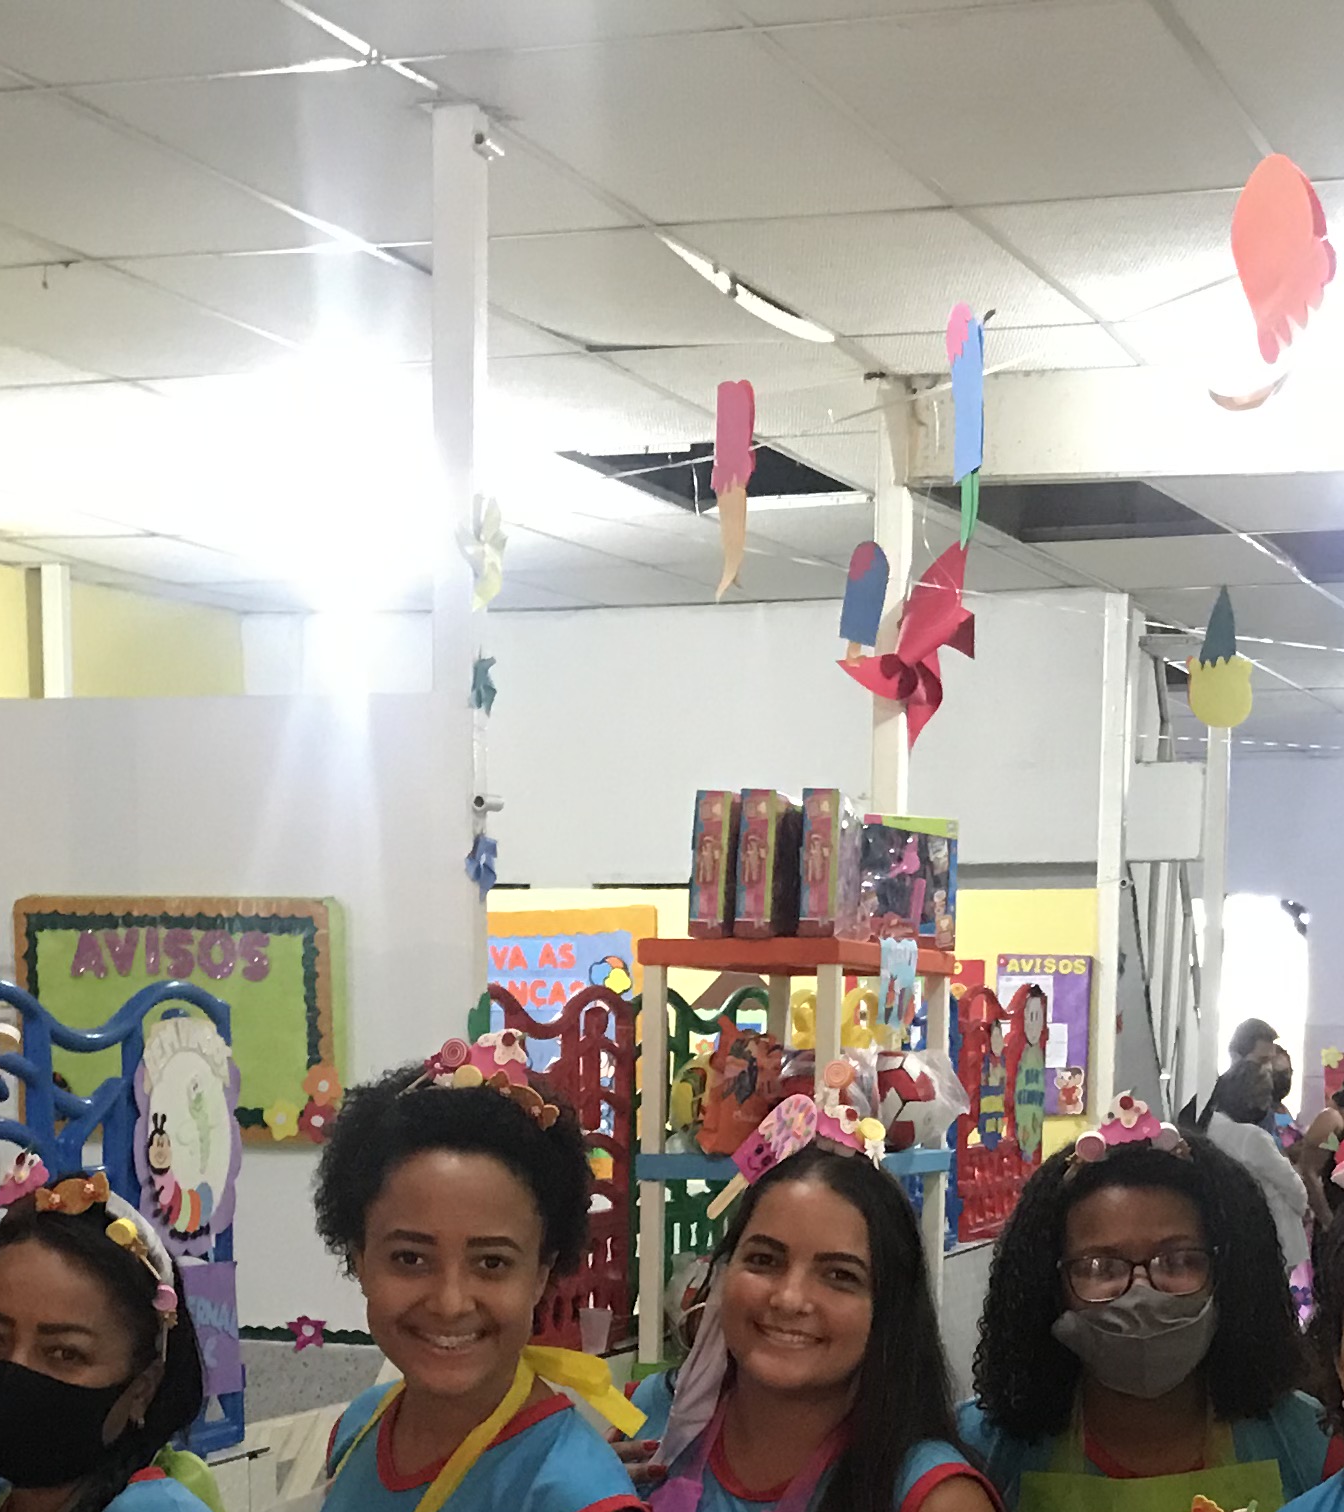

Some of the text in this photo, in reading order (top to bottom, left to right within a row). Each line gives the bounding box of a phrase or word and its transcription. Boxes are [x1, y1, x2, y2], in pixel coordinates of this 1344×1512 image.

[70, 926, 272, 983] AVISOS
[538, 942, 577, 970] AS
[1006, 957, 1087, 975] AVISOS
